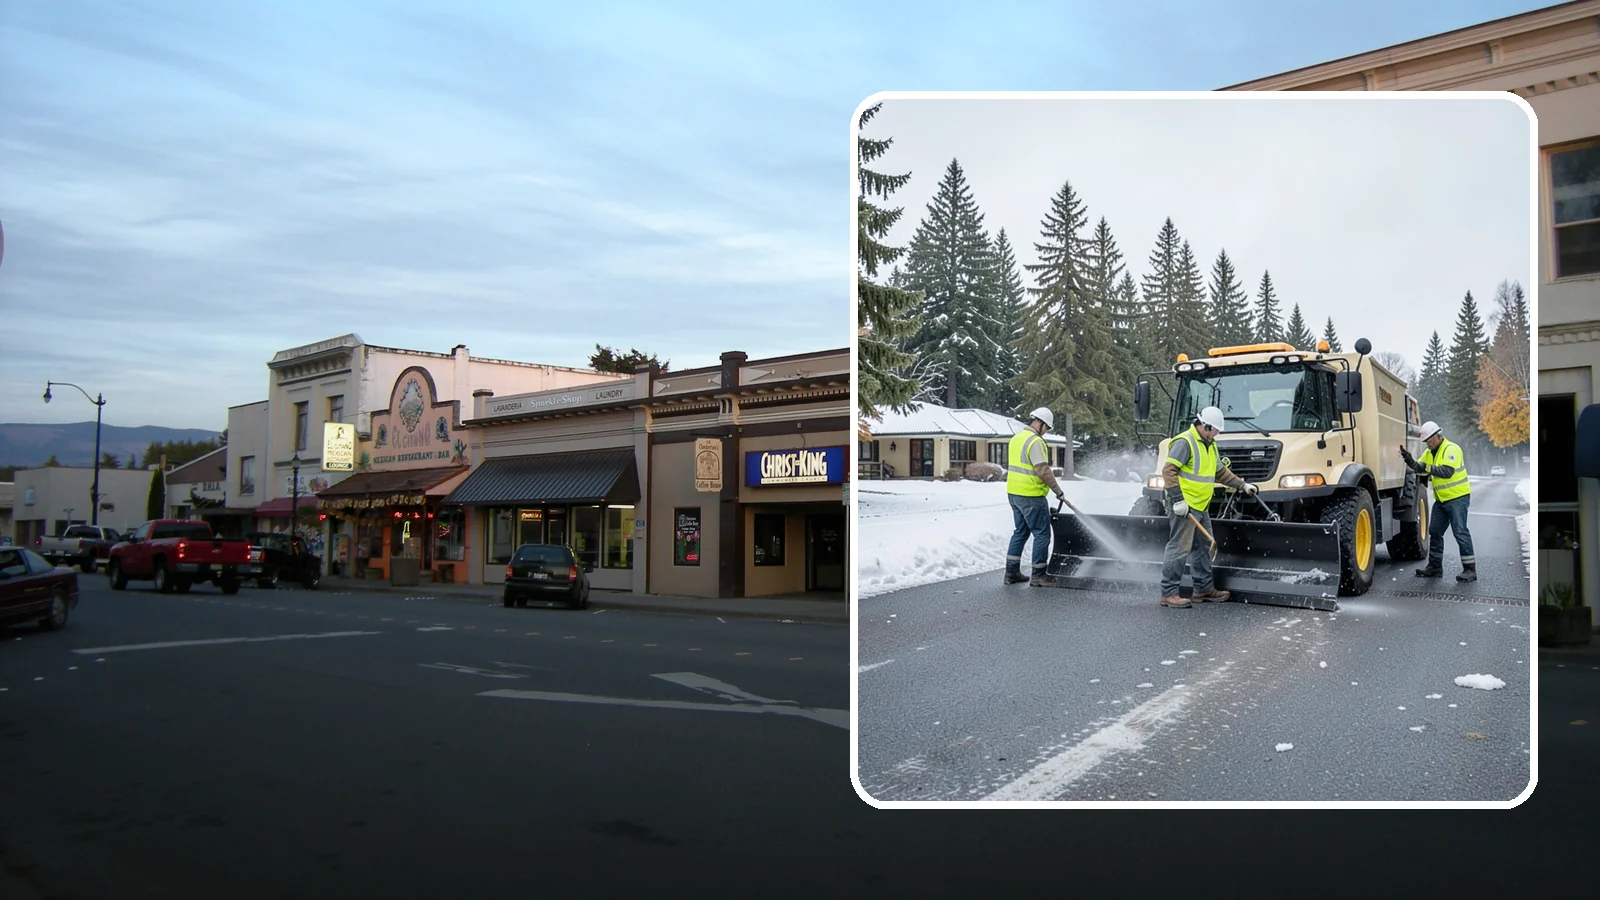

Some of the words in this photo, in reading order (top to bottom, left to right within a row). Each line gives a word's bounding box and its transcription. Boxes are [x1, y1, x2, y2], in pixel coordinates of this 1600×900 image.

[530, 399, 560, 409] Sparkle
[561, 394, 582, 405] Shop
[595, 389, 623, 400] LAUNDRY
[493, 402, 522, 412] LAVANDERIA
[373, 455, 396, 464] MEXICAN
[397, 452, 433, 463] RESTAURANT
[438, 450, 450, 459] BAR
[761, 452, 797, 478] CHRIST
[799, 450, 827, 476] KING
